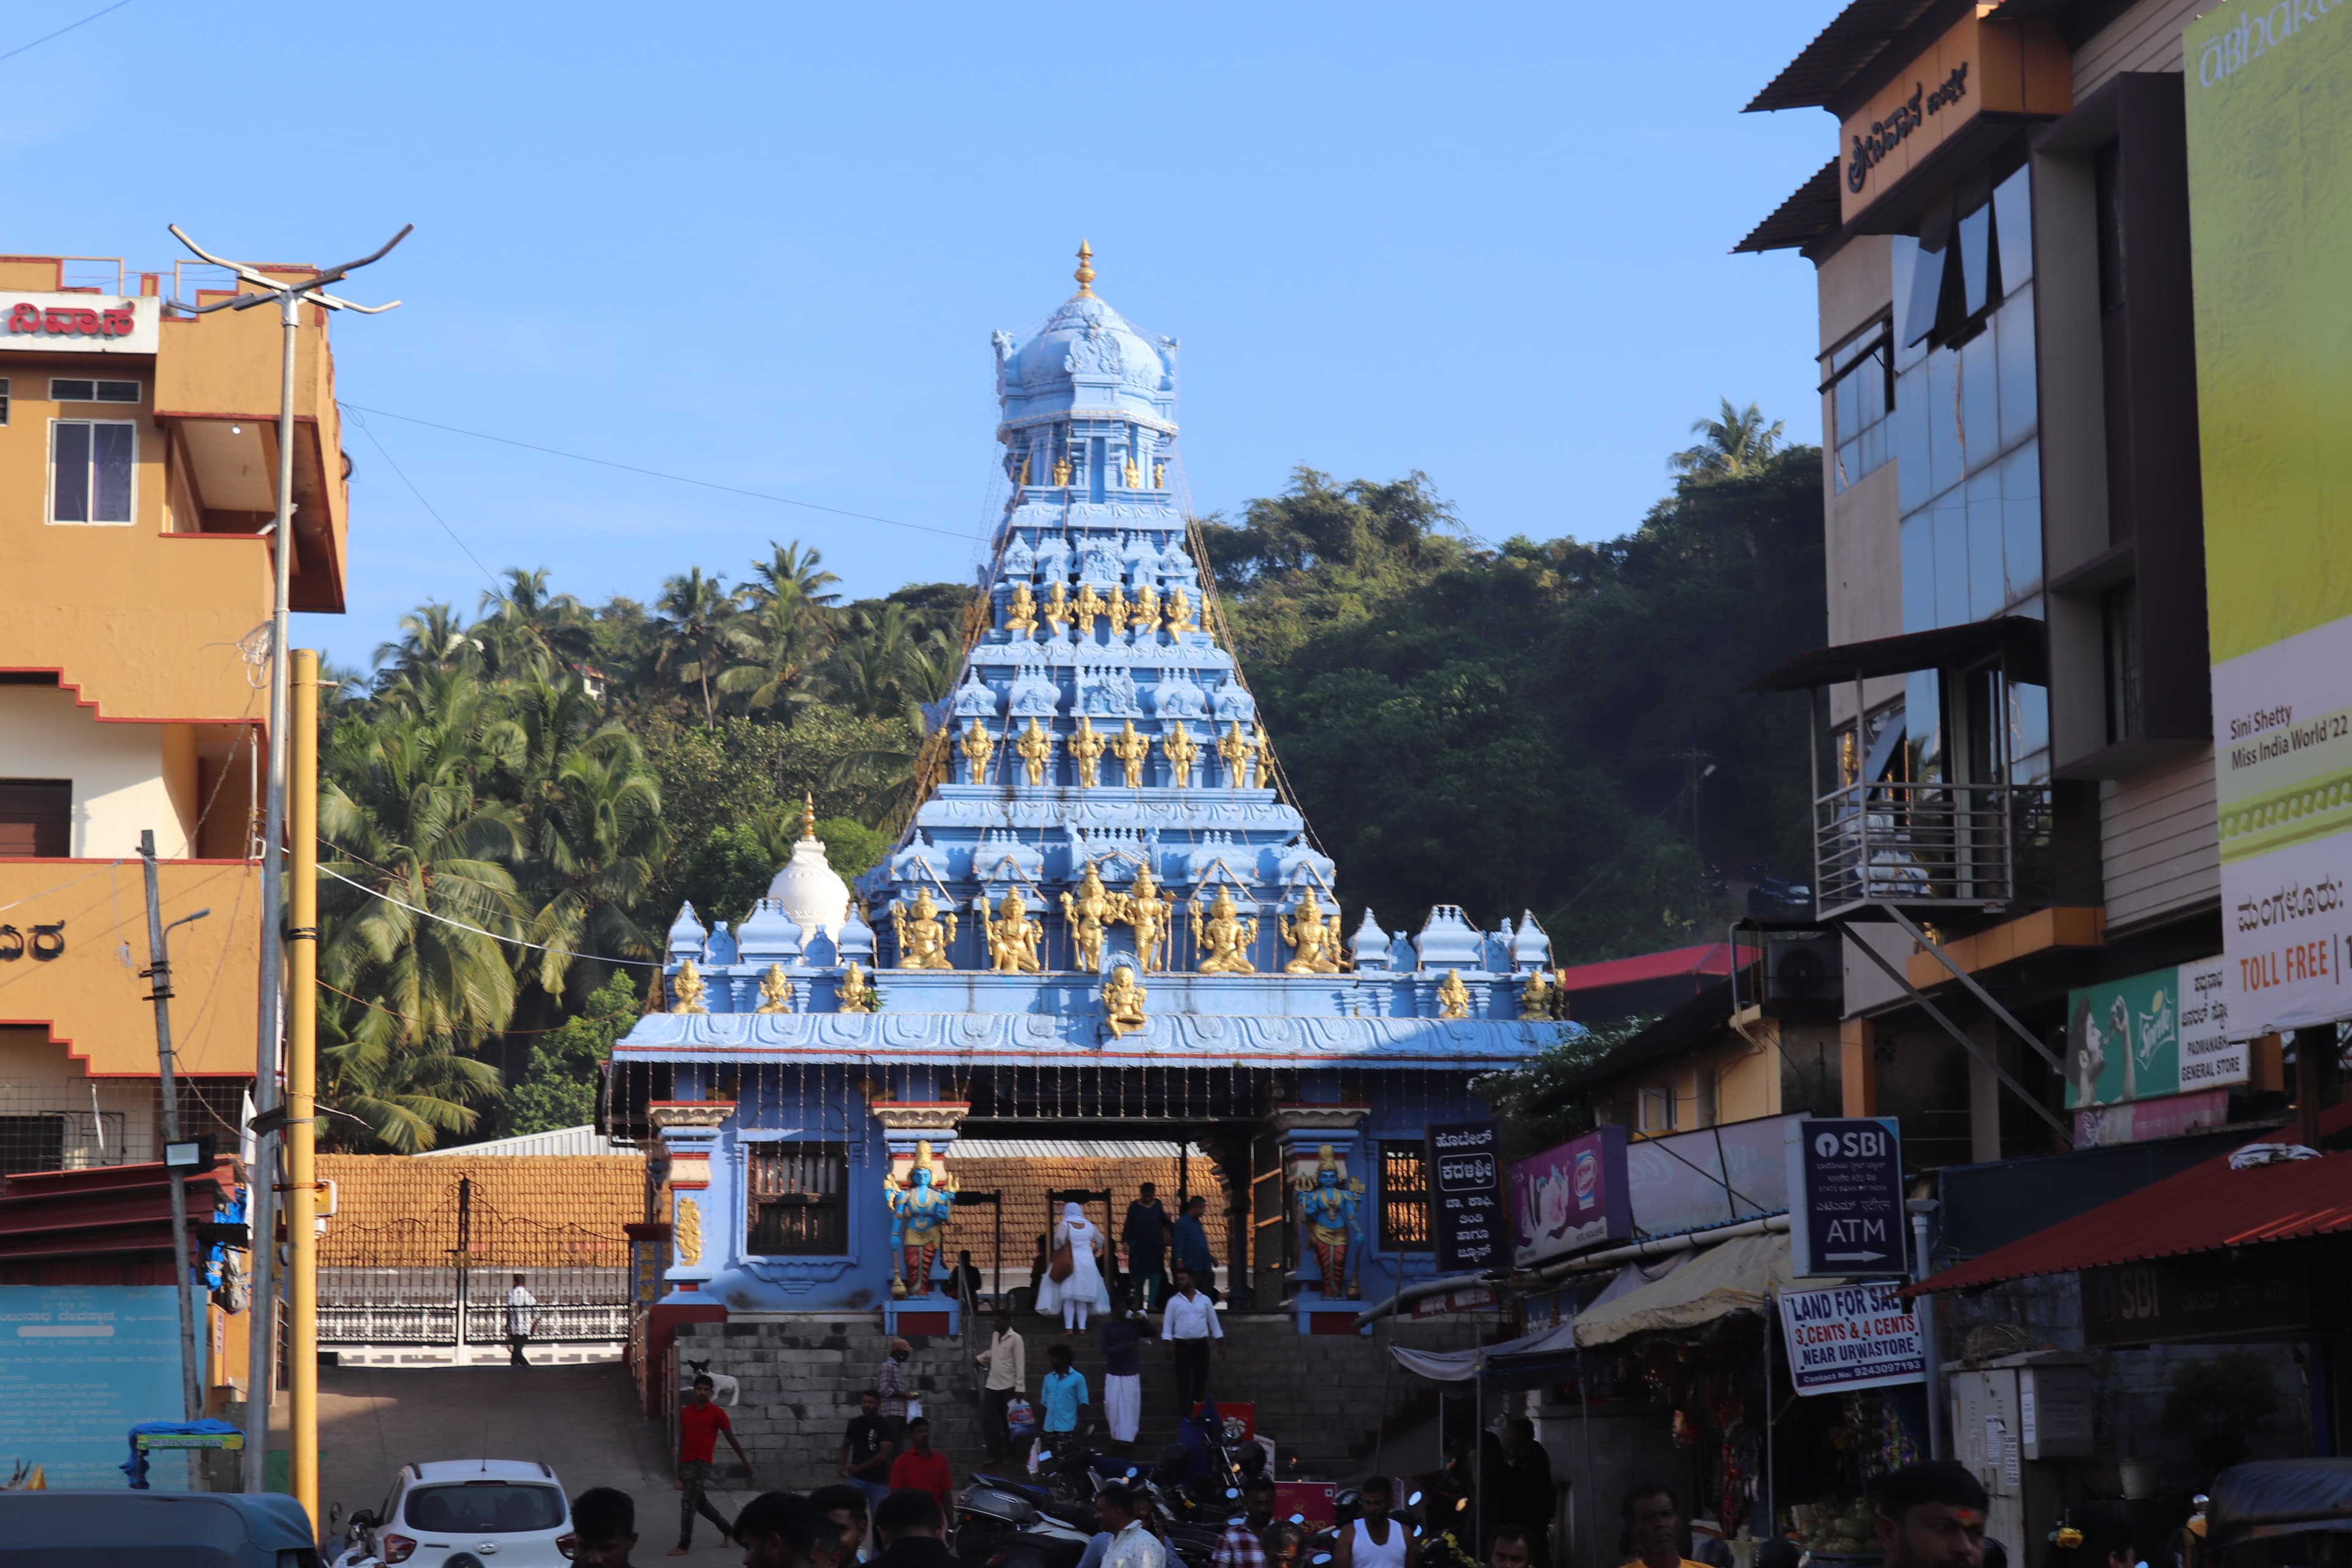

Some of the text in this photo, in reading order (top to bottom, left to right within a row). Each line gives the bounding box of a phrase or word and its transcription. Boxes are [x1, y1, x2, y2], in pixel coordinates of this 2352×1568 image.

[9, 300, 135, 336] ನಿವಾಸ
[2230, 705, 2293, 741] Sini Shetty
[2231, 714, 2348, 771] Miss India World '22
[2240, 951, 2280, 993] TOLL
[2286, 940, 2328, 982] FREE
[2182, 1057, 2240, 1082] GENERAL STORE
[1842, 1132, 1887, 1157] SBI
[1826, 1218, 1886, 1243] ATM
[1791, 1286, 1900, 1322] LAND FOR SAL
[2121, 1267, 2160, 1321] SBI
[1796, 1314, 1915, 1345] 3 CENTS & 4 CENTS
[1803, 1336, 1915, 1366] NEAR URWASTORE
[1803, 1373, 1837, 1383] Contact
[1853, 1360, 1921, 1377] 9243097193
